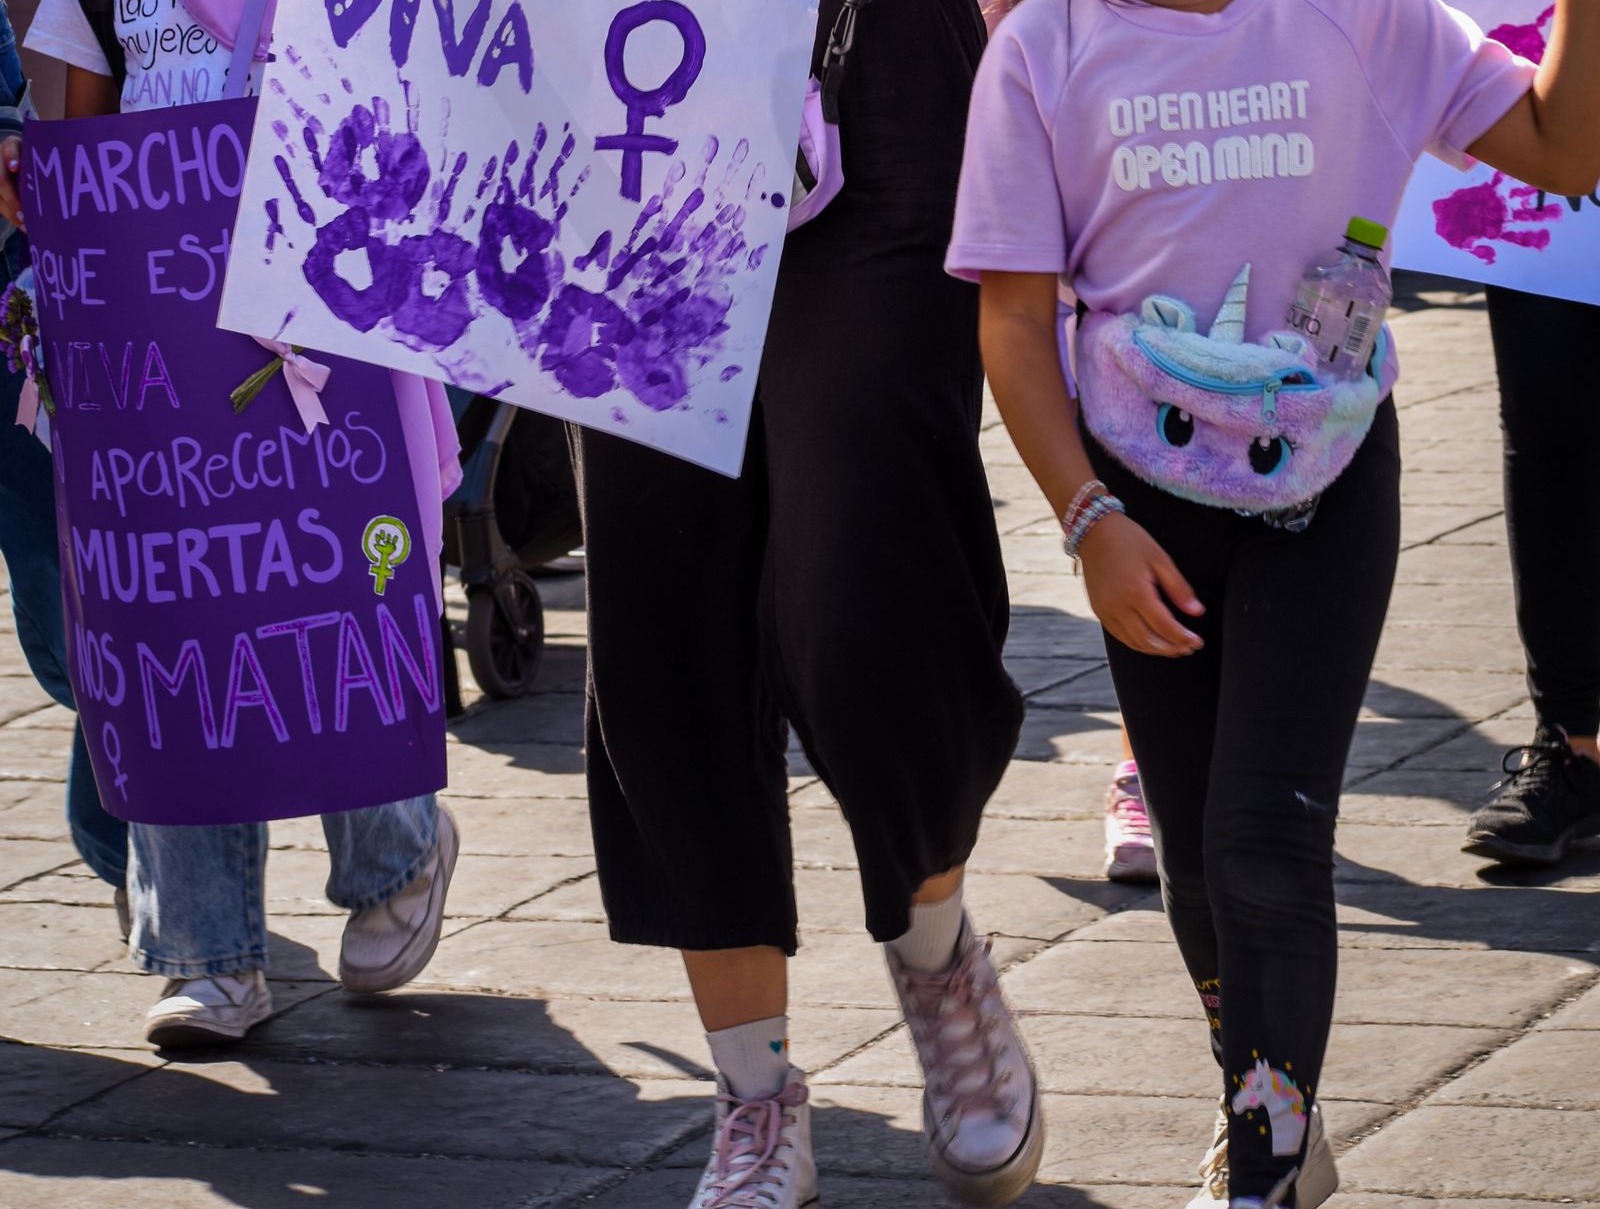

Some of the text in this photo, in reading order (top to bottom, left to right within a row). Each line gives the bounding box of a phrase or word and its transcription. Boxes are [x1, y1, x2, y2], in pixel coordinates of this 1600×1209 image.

[180, 68, 210, 105] NO
[1109, 80, 1310, 137] OPEN HEART
[31, 123, 247, 220] MARCHO
[1112, 133, 1315, 191] OPEN MIND
[52, 341, 181, 411] VIVA
[72, 508, 344, 604] MUERTAS
[75, 594, 441, 750] NOS MATAN
